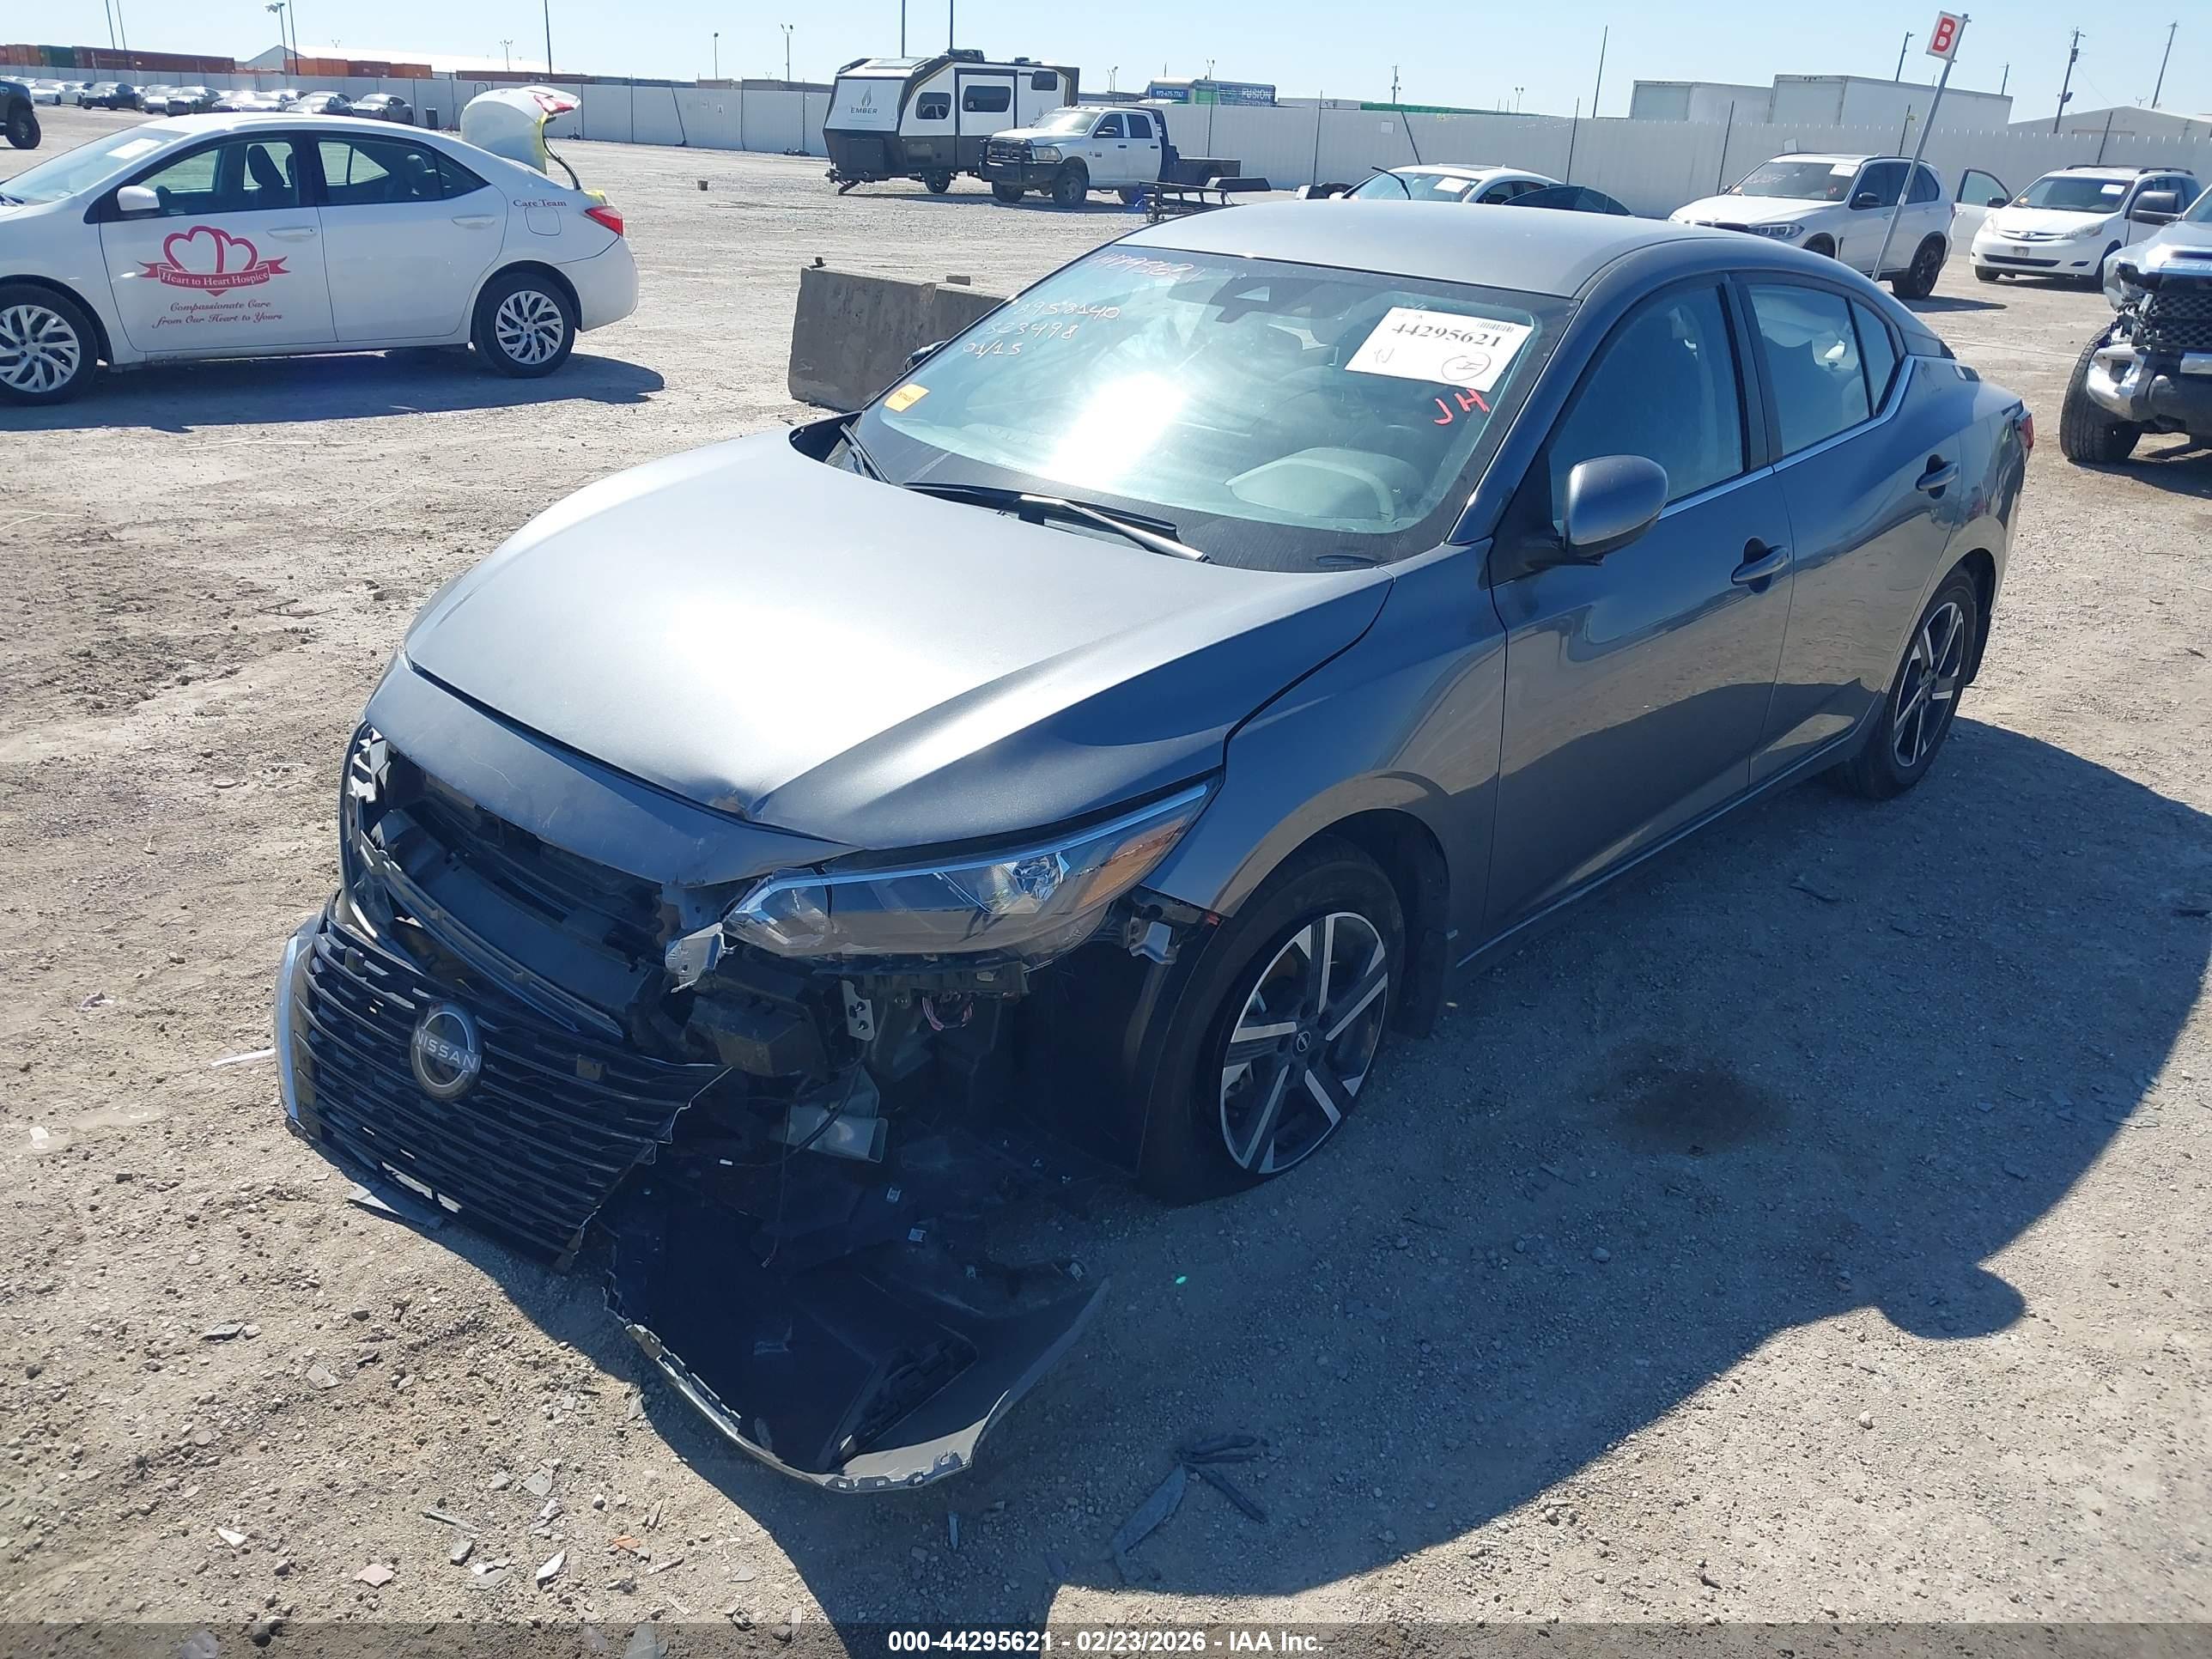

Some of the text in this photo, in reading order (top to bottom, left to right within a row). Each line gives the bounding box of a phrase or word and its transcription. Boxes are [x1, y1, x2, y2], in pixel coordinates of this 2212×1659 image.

[1932, 17, 1956, 52] B
[1242, 88, 1271, 100] FUSION
[538, 198, 567, 207] Team
[161, 271, 190, 284] Heart
[204, 276, 231, 286] Heart
[232, 272, 269, 286] Hospice
[170, 300, 271, 313] Compassionate Care
[152, 315, 185, 329] from
[185, 314, 205, 324] Our
[208, 313, 239, 323] Heart
[252, 312, 283, 323] Yours
[1391, 322, 1503, 348] 44295621
[414, 1030, 477, 1069] NISSAN
